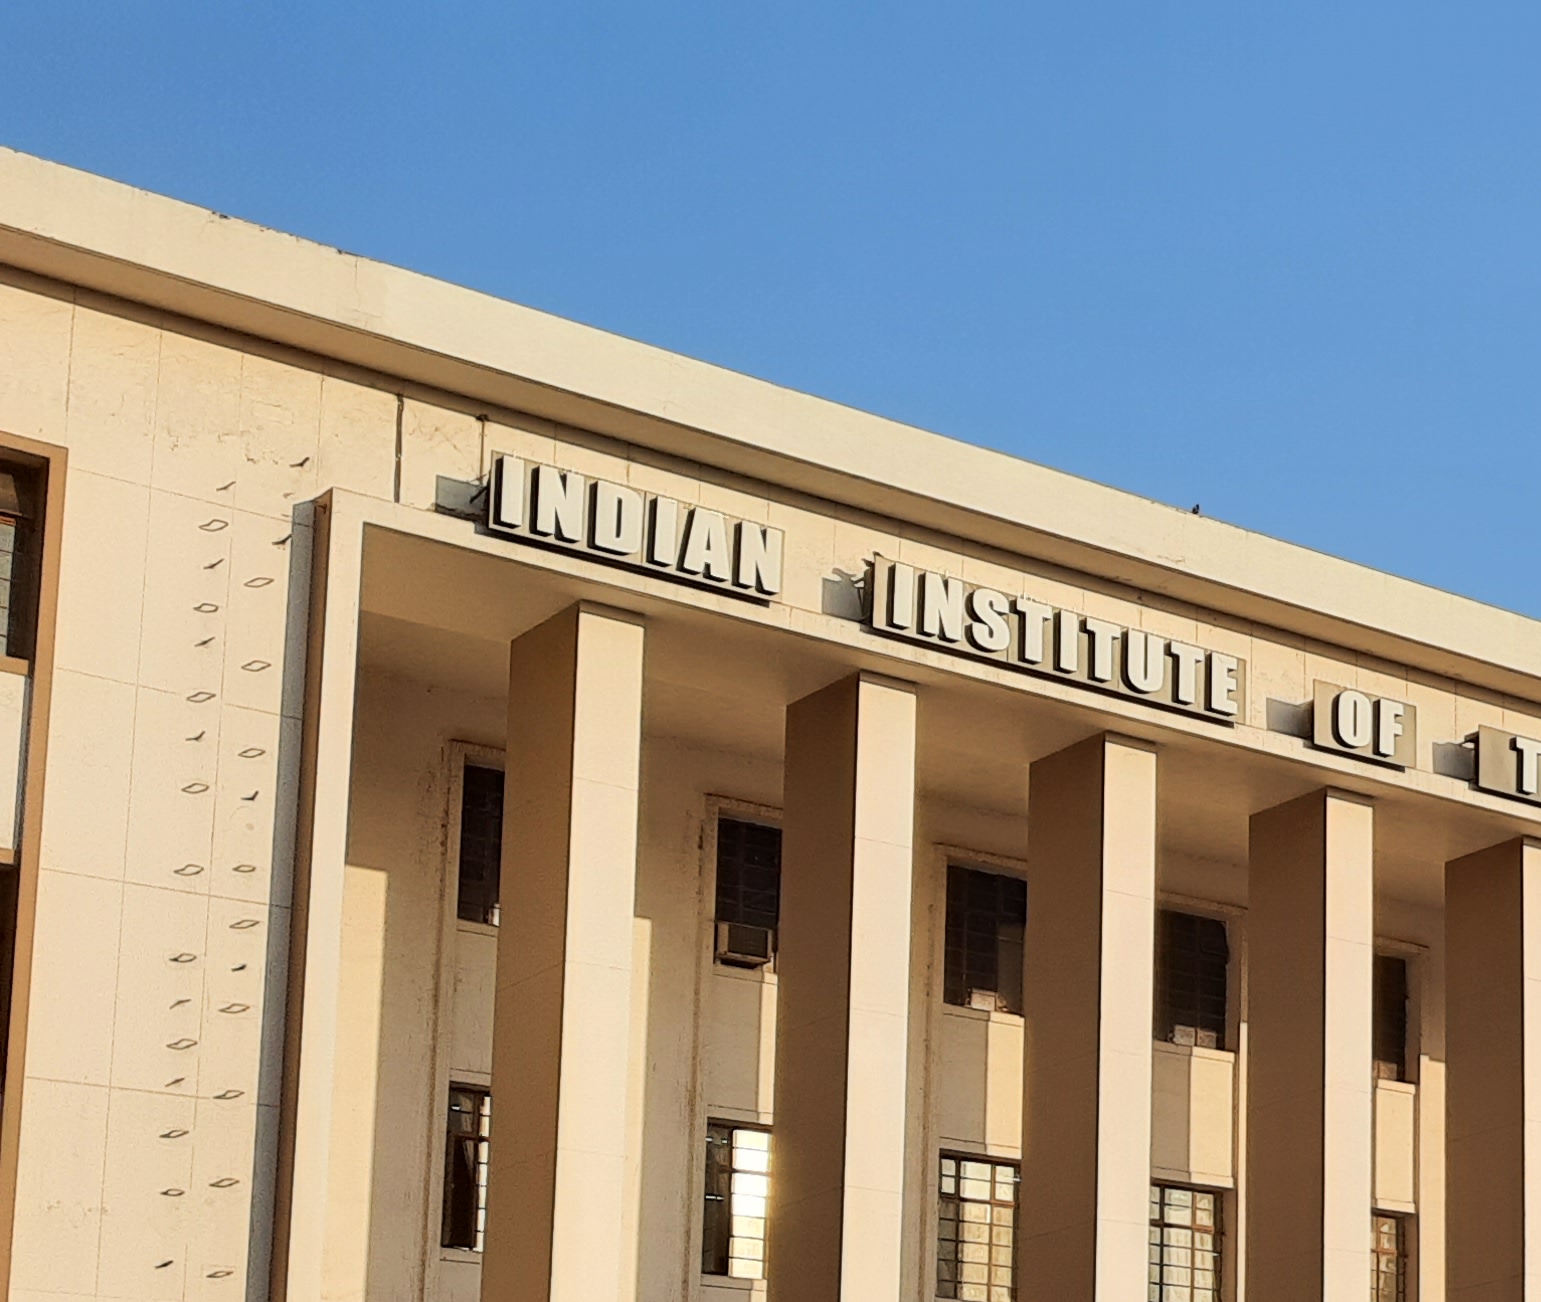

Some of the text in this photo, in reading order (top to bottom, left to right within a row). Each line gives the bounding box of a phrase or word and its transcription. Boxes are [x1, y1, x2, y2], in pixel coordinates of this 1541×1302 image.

[495, 456, 780, 594] INDIAN
[886, 563, 1240, 714] INSTITUTE
[1333, 689, 1404, 757] OF
